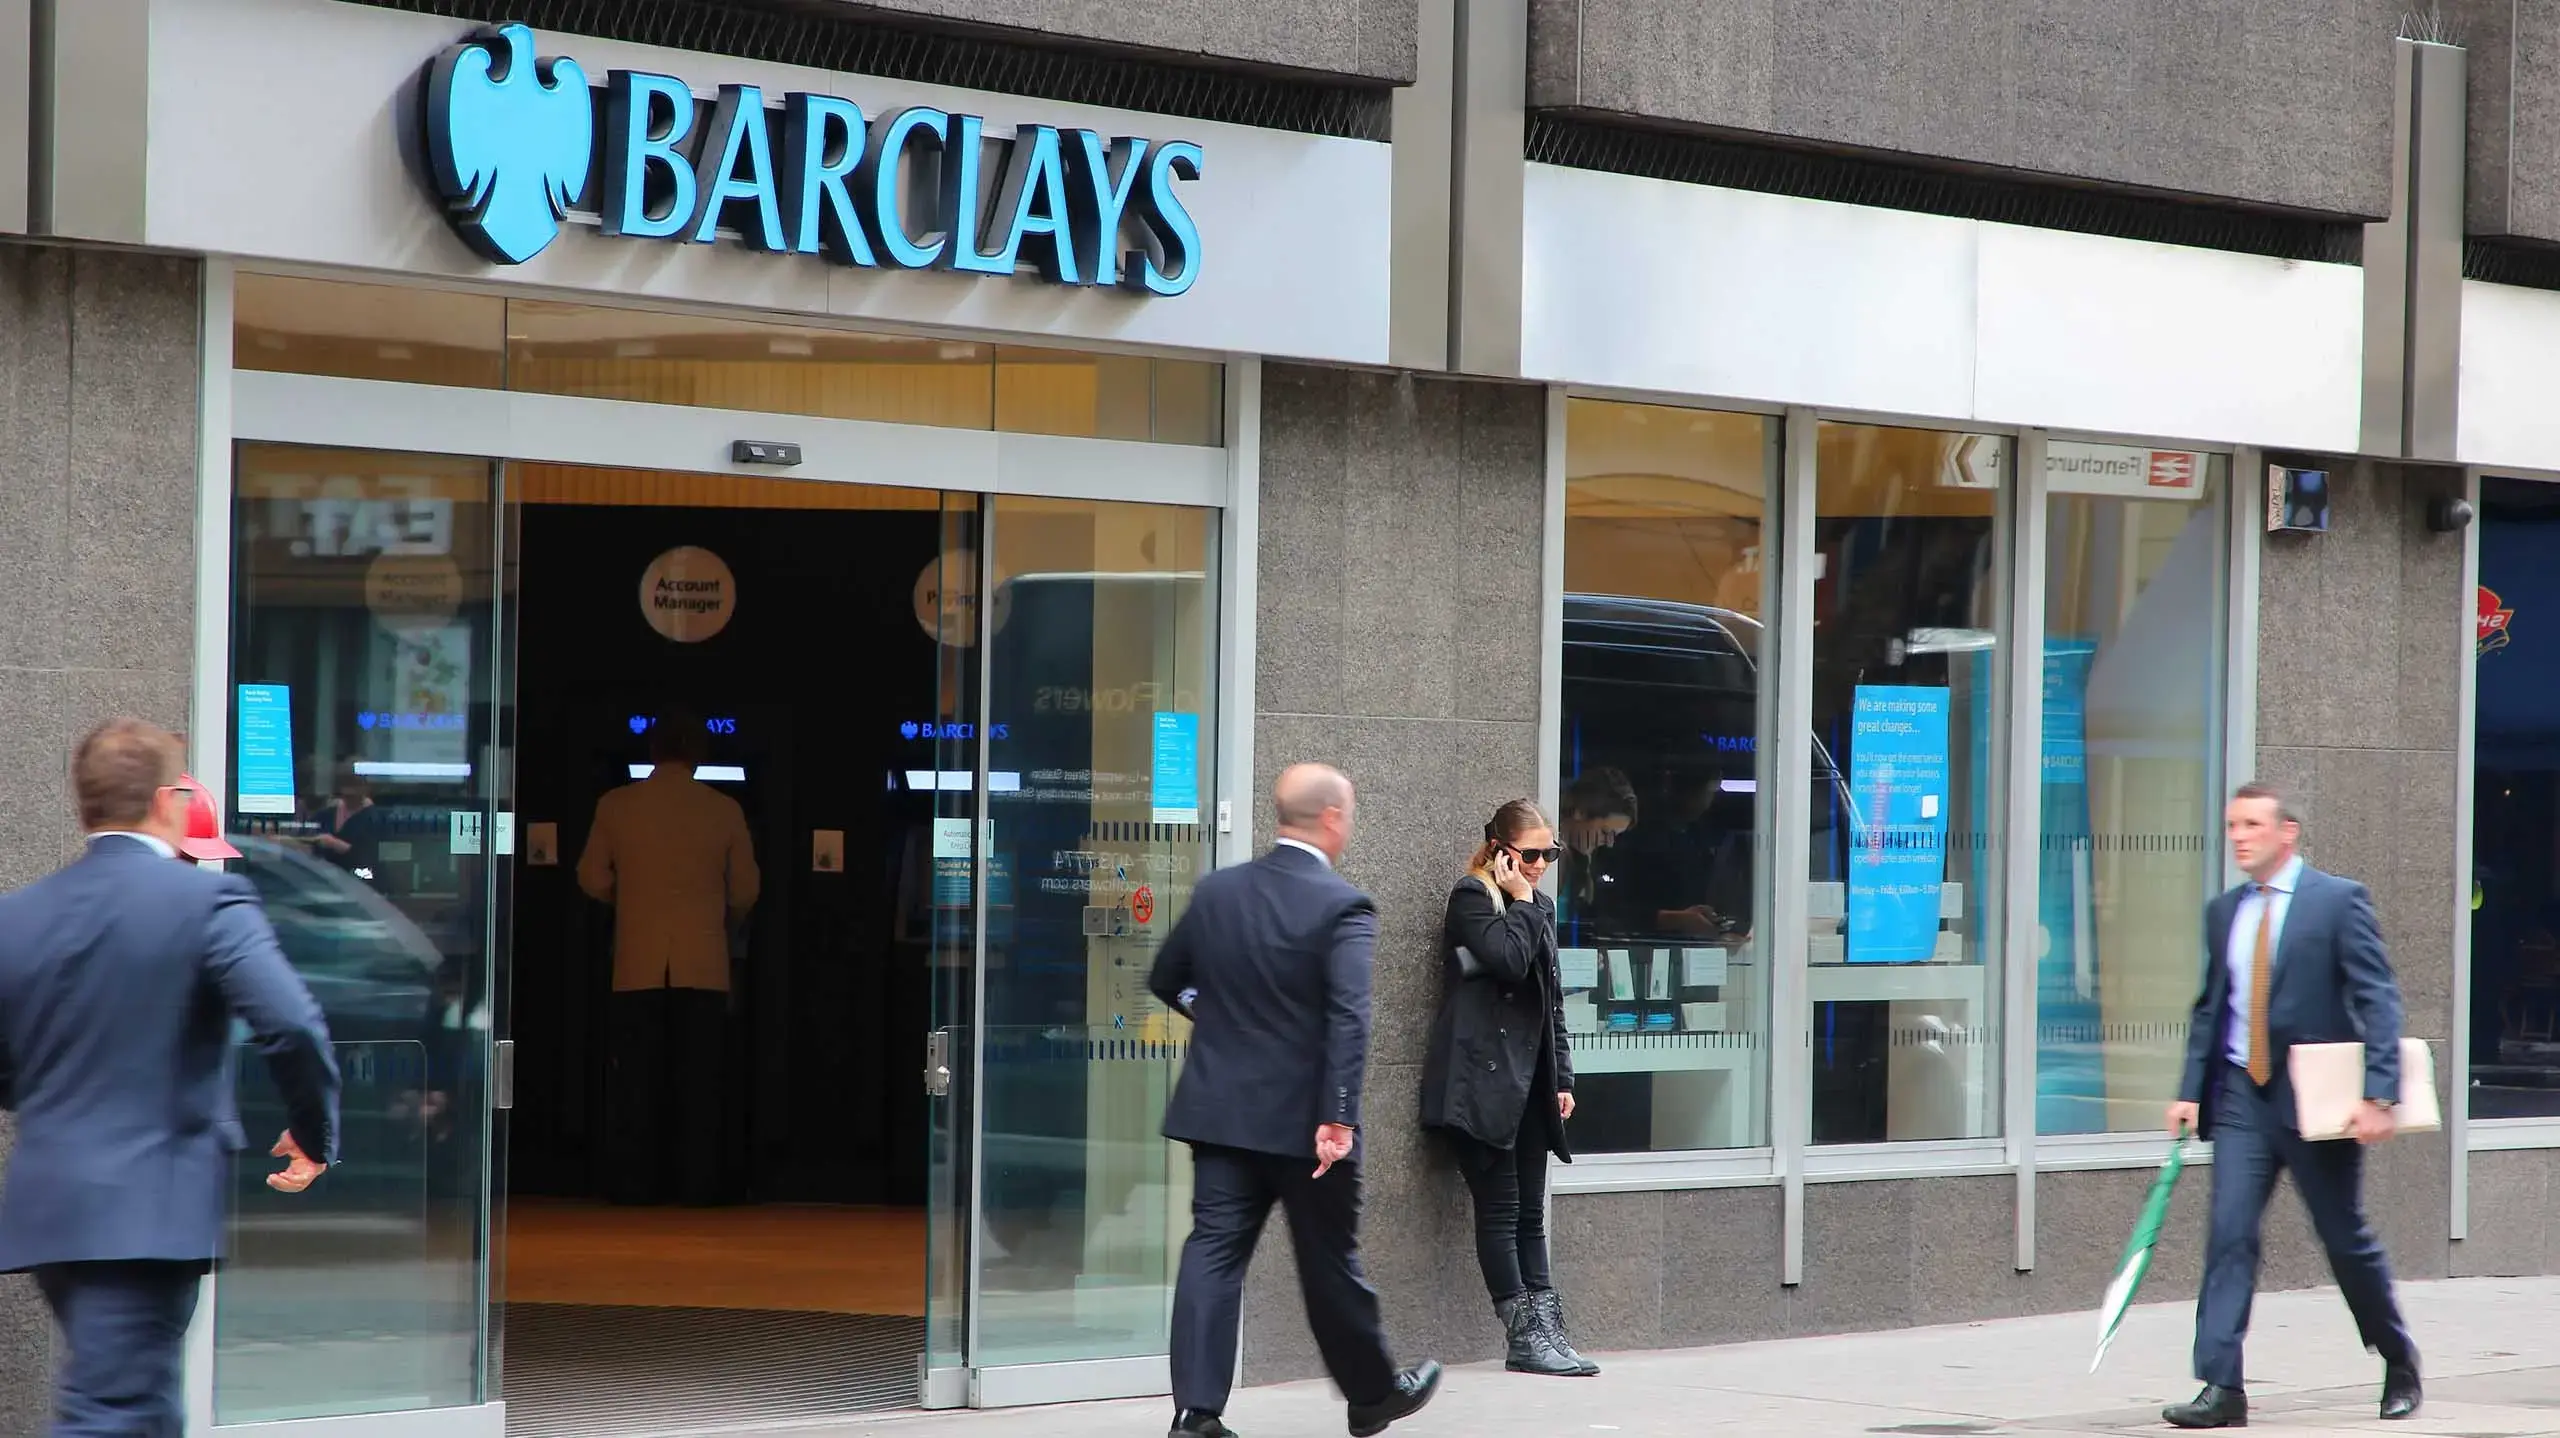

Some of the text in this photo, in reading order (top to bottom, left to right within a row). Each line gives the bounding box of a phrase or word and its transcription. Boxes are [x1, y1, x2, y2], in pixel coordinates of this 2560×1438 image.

[607, 69, 1203, 298] BARCLAYS
[656, 577, 720, 593] Account
[654, 595, 721, 614] Manager
[1860, 698, 1938, 716] We are making some
[1857, 719, 1880, 736] great
[1717, 735, 1759, 752] BARC
